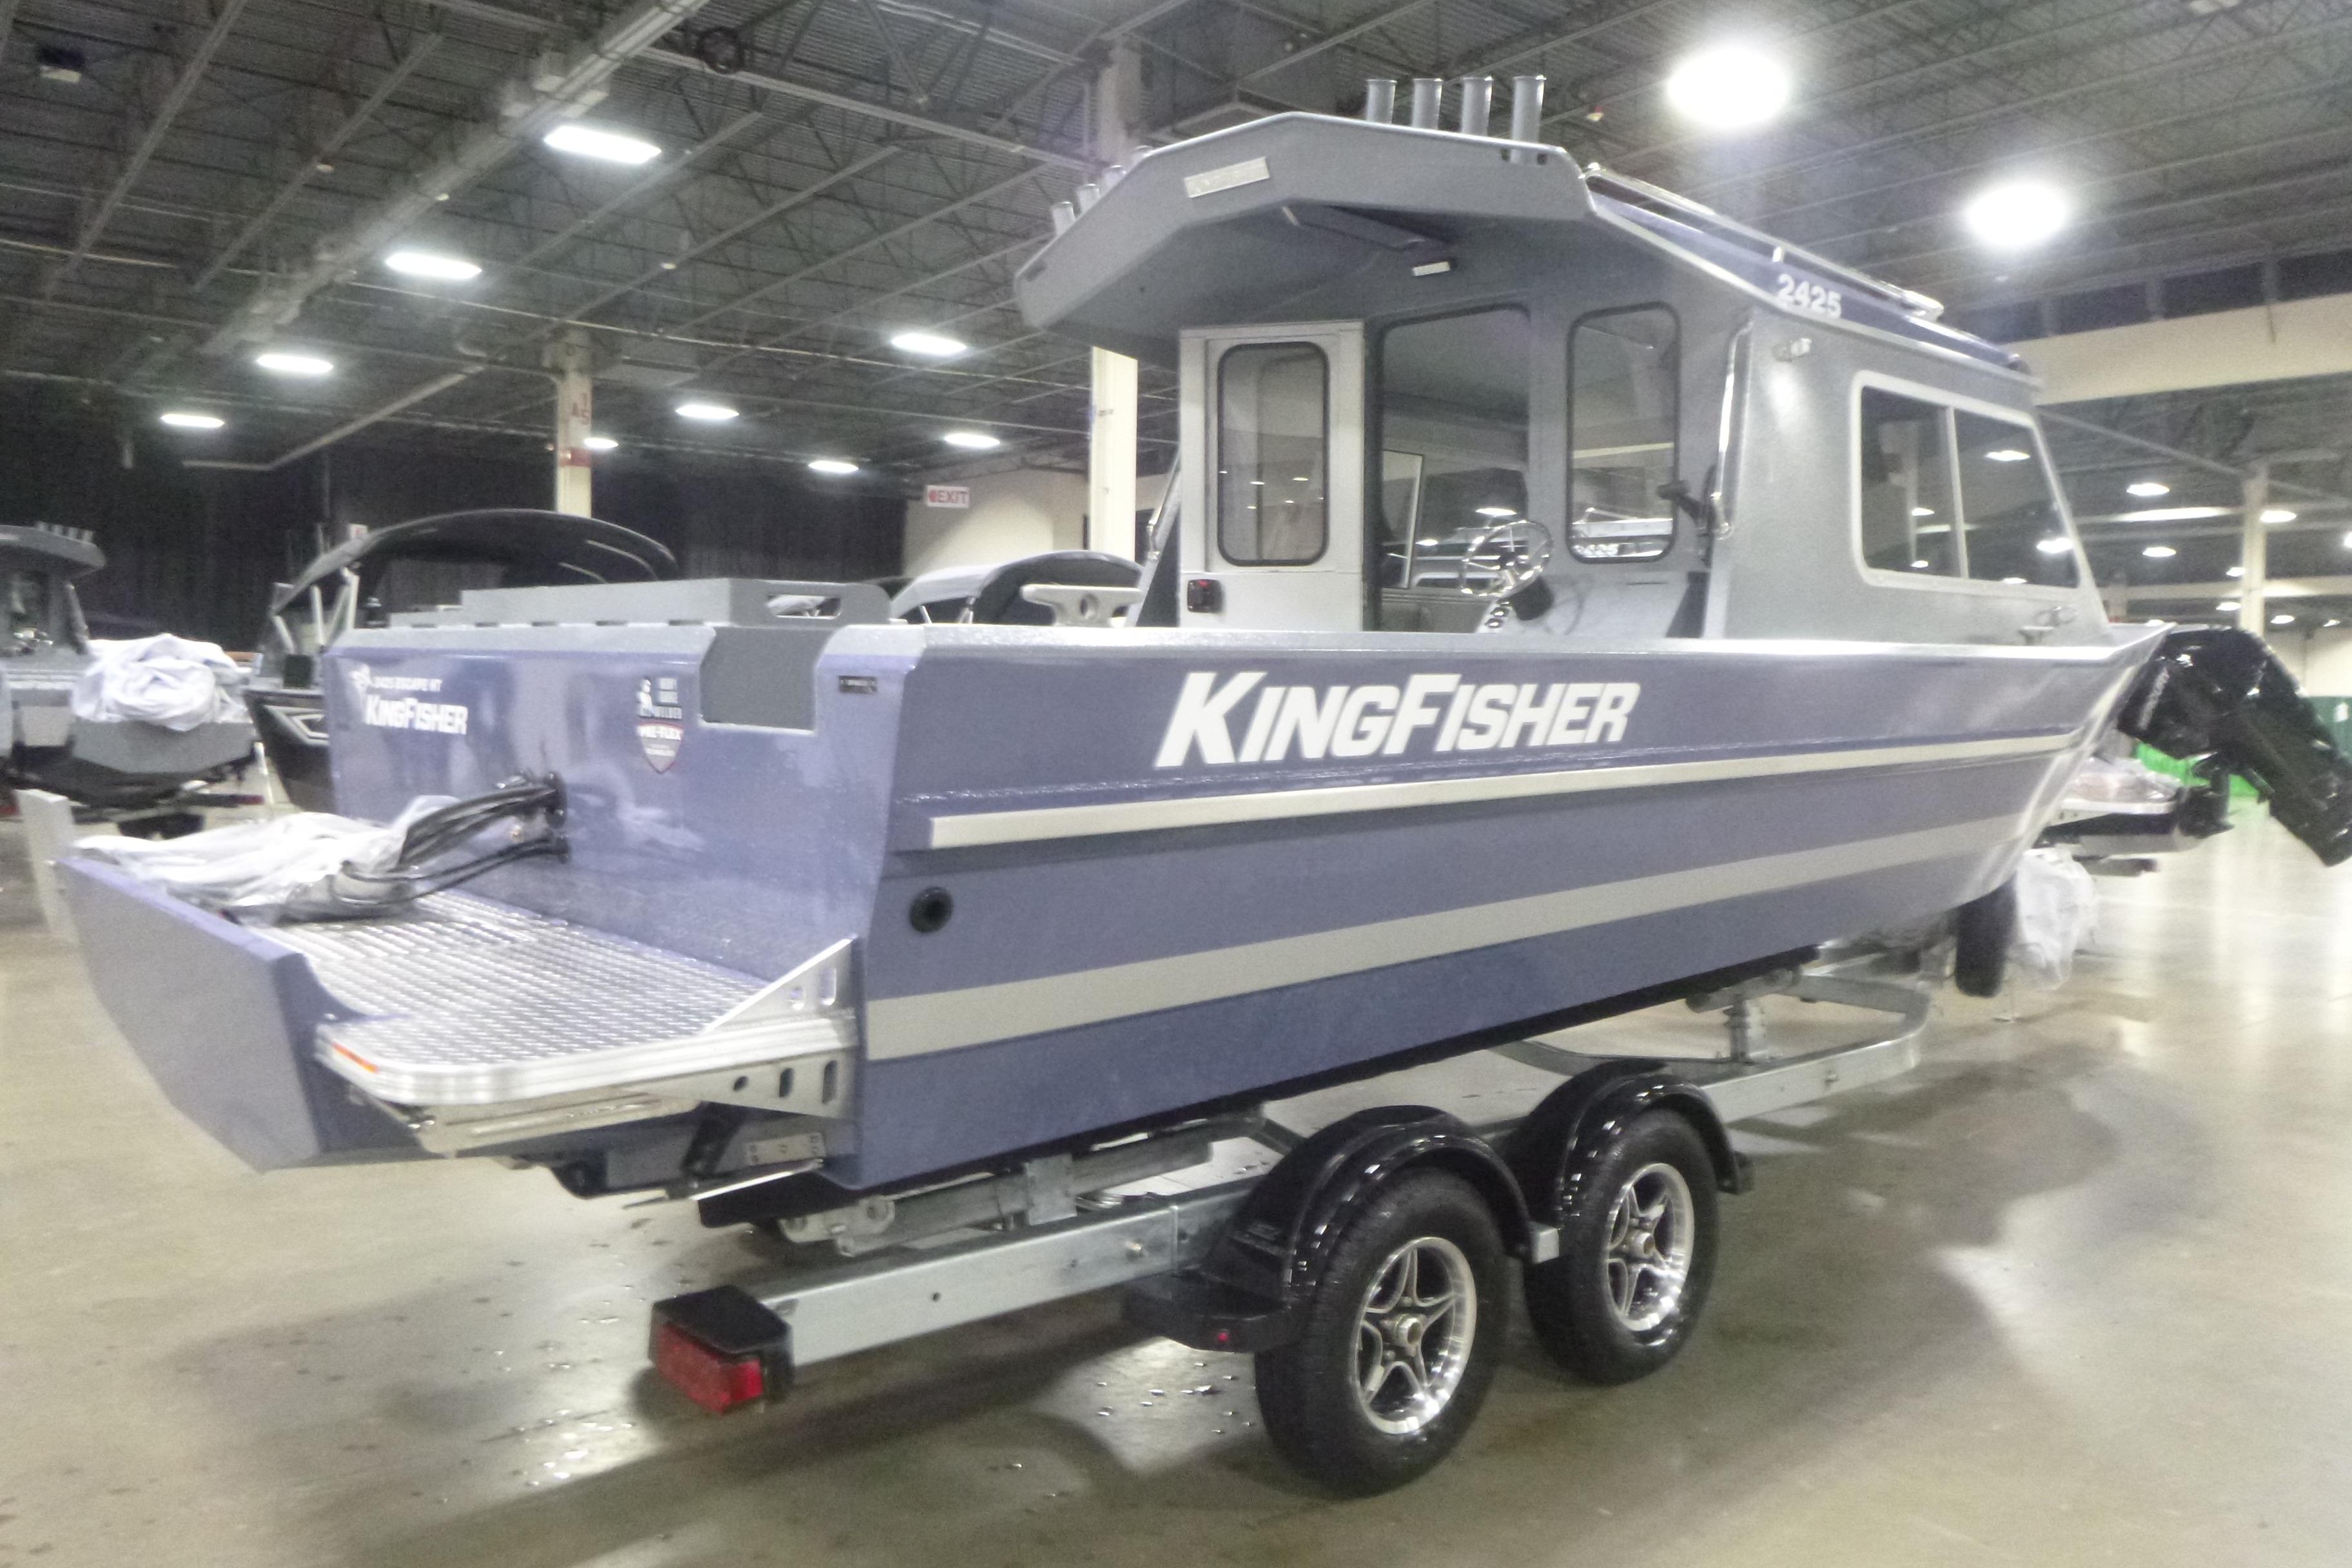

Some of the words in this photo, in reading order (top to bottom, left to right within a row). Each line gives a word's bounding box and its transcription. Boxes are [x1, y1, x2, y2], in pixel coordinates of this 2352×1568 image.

[1778, 273, 1843, 319] 2425
[938, 490, 968, 504] EXIT
[365, 694, 469, 735] KINGFISHER
[1155, 671, 1641, 769] KINGFISHER
